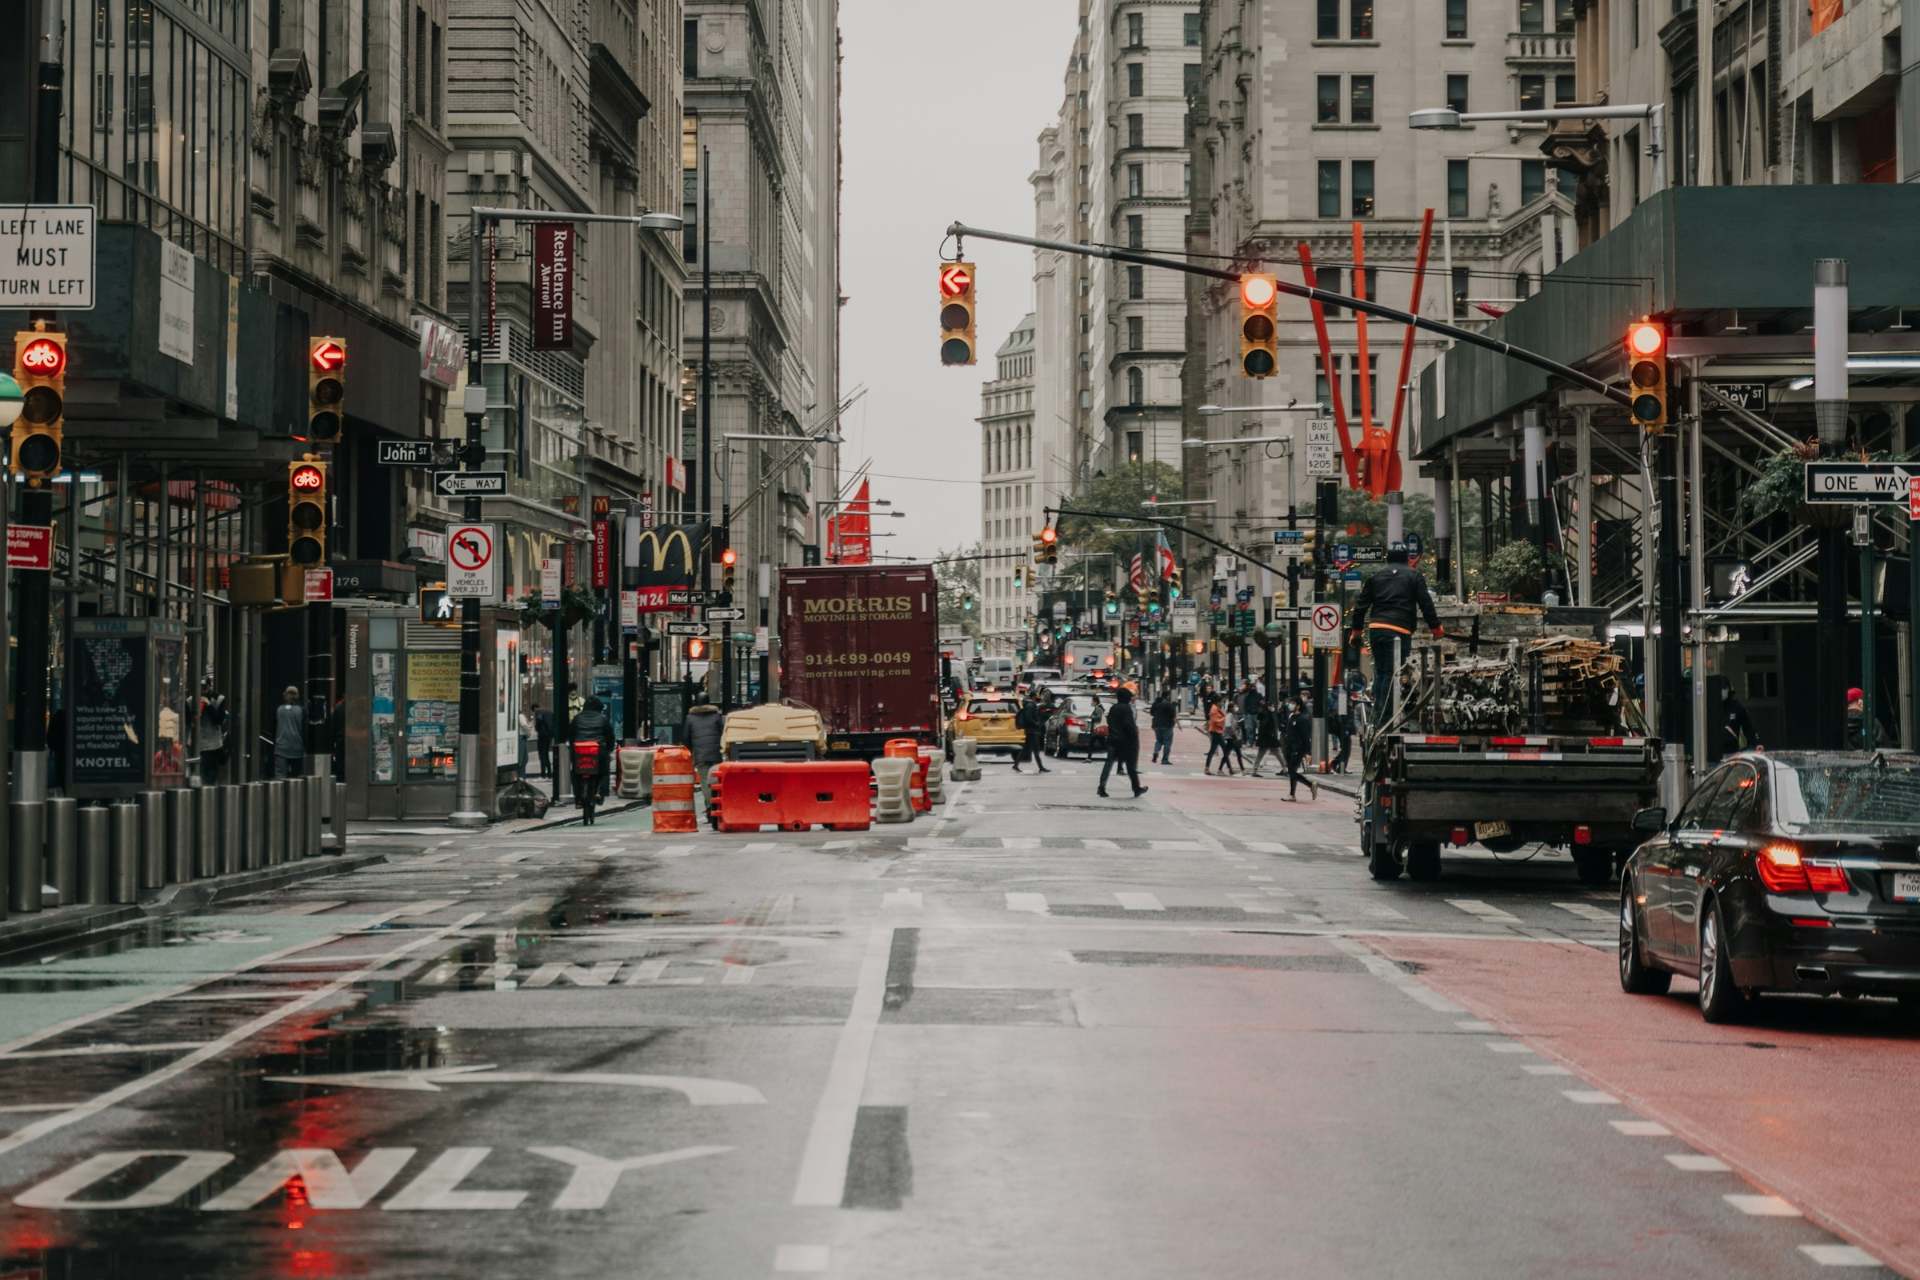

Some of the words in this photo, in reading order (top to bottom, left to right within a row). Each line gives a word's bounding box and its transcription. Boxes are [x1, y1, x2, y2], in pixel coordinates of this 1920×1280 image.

[1, 219, 36, 235] LEFT
[46, 219, 85, 235] LANE
[17, 247, 68, 266] MUST
[553, 230, 568, 309] Residence
[0, 279, 39, 294] TURN
[49, 279, 84, 294] LEFT
[541, 263, 551, 308] Marriott
[553, 312, 566, 342] Inn
[1312, 422, 1328, 431] BUS
[1309, 433, 1330, 441] LANE
[384, 446, 416, 461] John
[418, 447, 428, 455] ST
[1309, 460, 1331, 468] $205
[446, 480, 467, 489] ONE
[475, 480, 497, 489] WAY
[1824, 476, 1858, 490] ONE
[1874, 476, 1909, 490] WAY
[336, 577, 359, 587] 176
[650, 592, 664, 606] 24
[803, 596, 912, 614] MORRIS
[859, 612, 912, 621] STORAGE
[12, 1145, 738, 1212] ONLY
